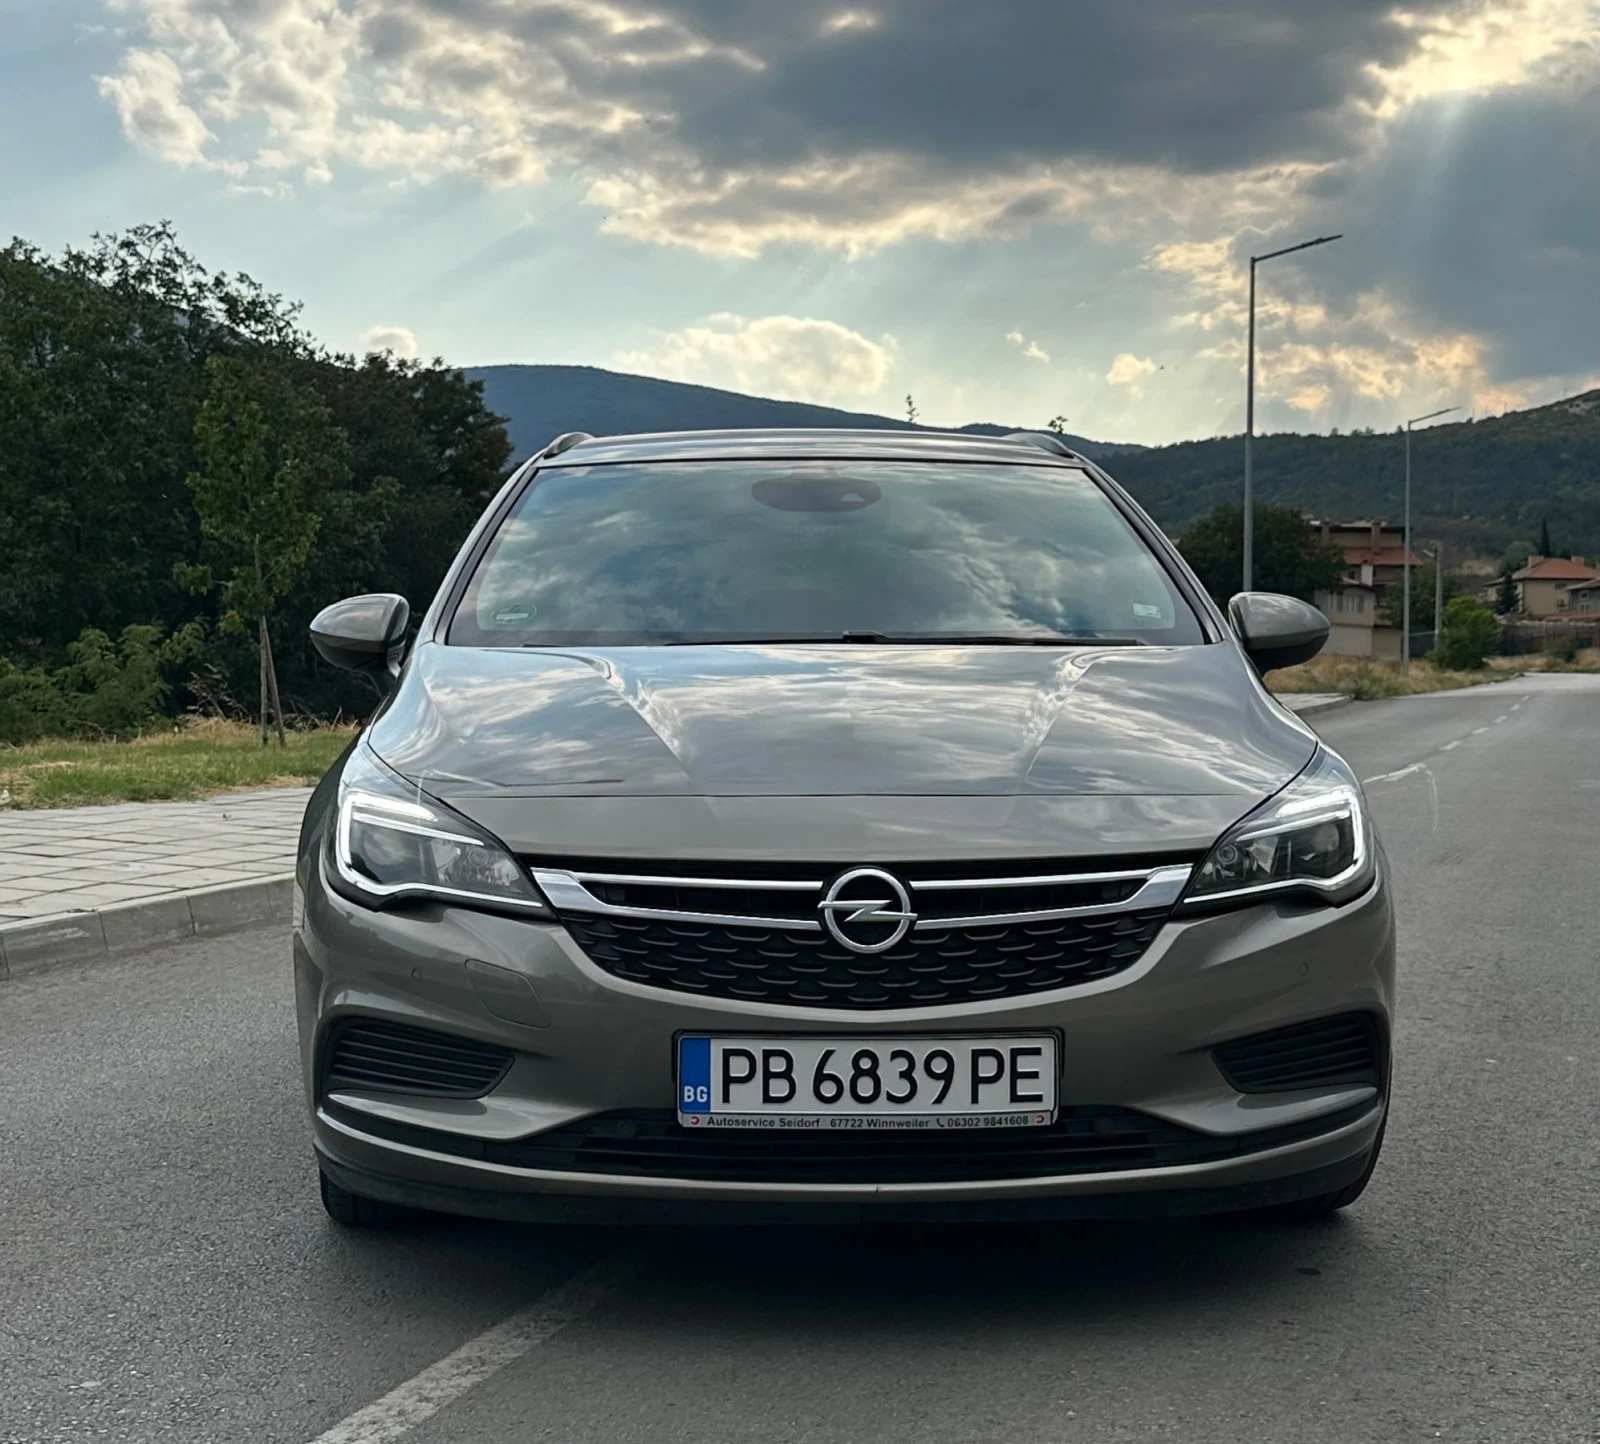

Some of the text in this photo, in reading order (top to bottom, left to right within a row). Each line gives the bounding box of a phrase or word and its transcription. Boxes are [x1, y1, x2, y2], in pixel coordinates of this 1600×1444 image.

[722, 1047, 1044, 1104] PB 6839 PE
[683, 1086, 708, 1103] BG
[706, 1116, 775, 1127] Autoservice
[830, 1118, 863, 1128] 67722
[866, 1118, 930, 1128] Winnweiler
[947, 1118, 980, 1127] 06302
[983, 1115, 1029, 1126] 9841608
